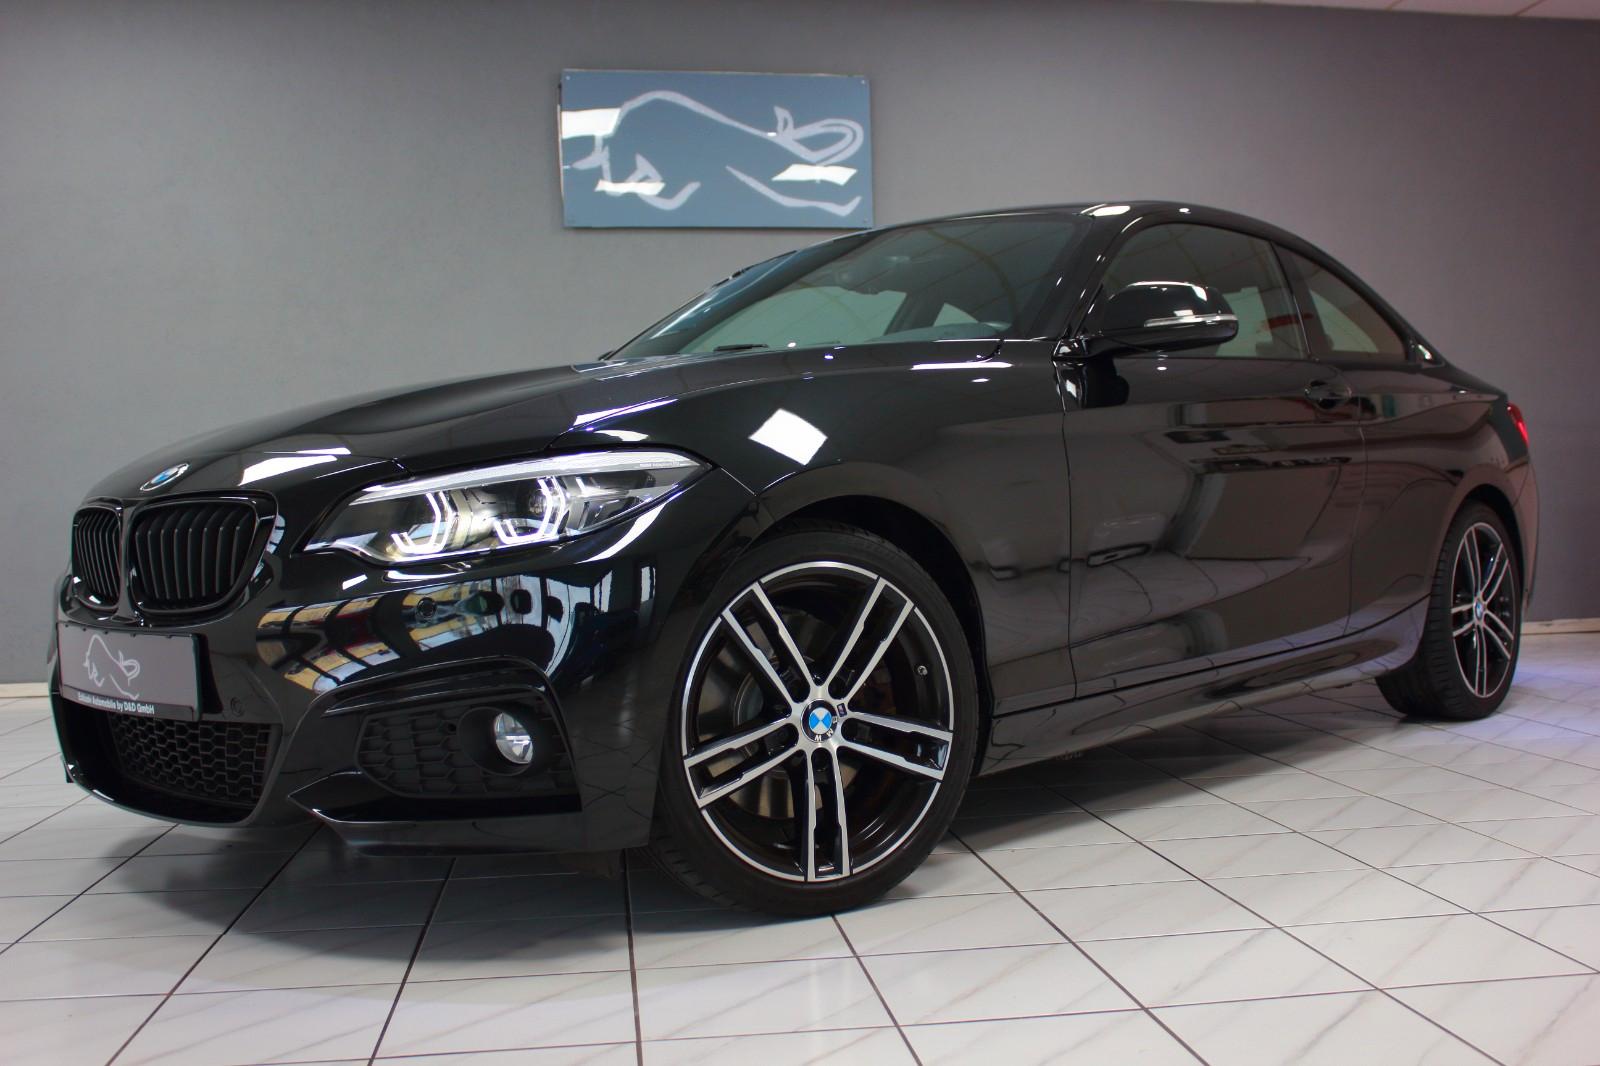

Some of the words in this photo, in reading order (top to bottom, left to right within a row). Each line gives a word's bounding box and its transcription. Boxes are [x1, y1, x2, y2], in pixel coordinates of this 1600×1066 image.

[117, 700, 124, 712] by
[124, 701, 137, 712] D&D
[137, 703, 155, 715] GmbH
